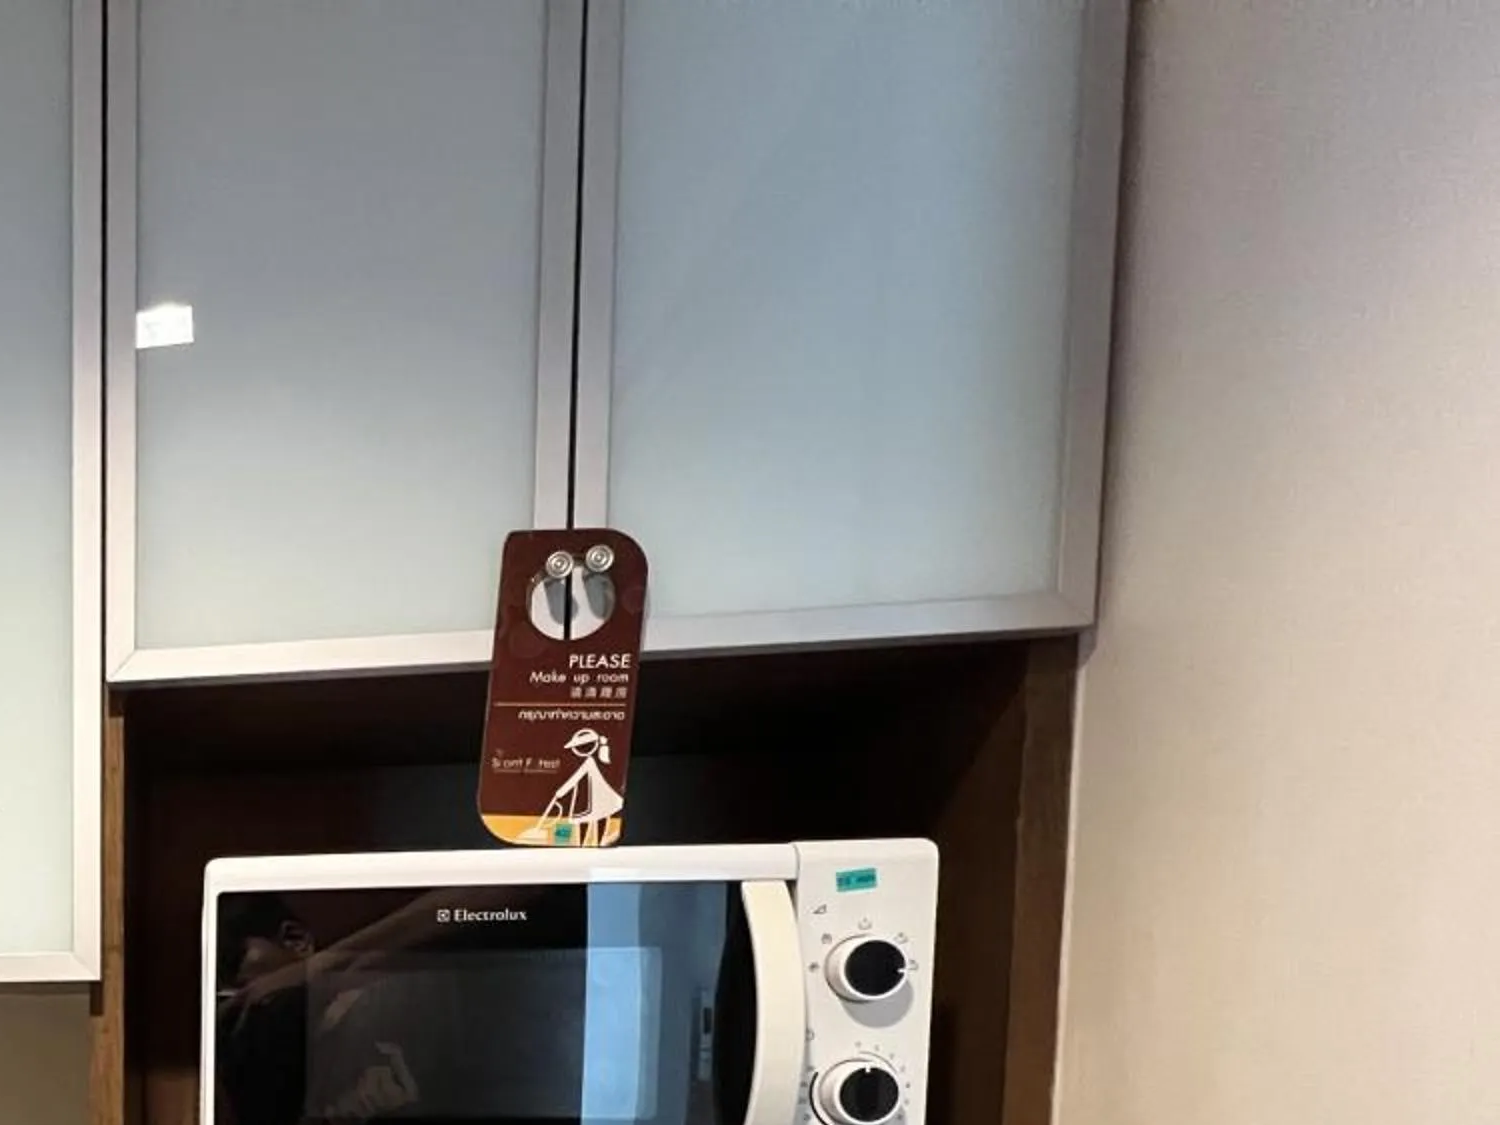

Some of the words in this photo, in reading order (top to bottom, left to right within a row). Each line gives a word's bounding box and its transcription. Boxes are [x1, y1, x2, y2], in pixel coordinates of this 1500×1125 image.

[568, 653, 632, 669] PLEASE
[529, 669, 567, 684] Make
[573, 673, 591, 685] up
[597, 673, 629, 683] room
[453, 907, 528, 922] Electrolux
